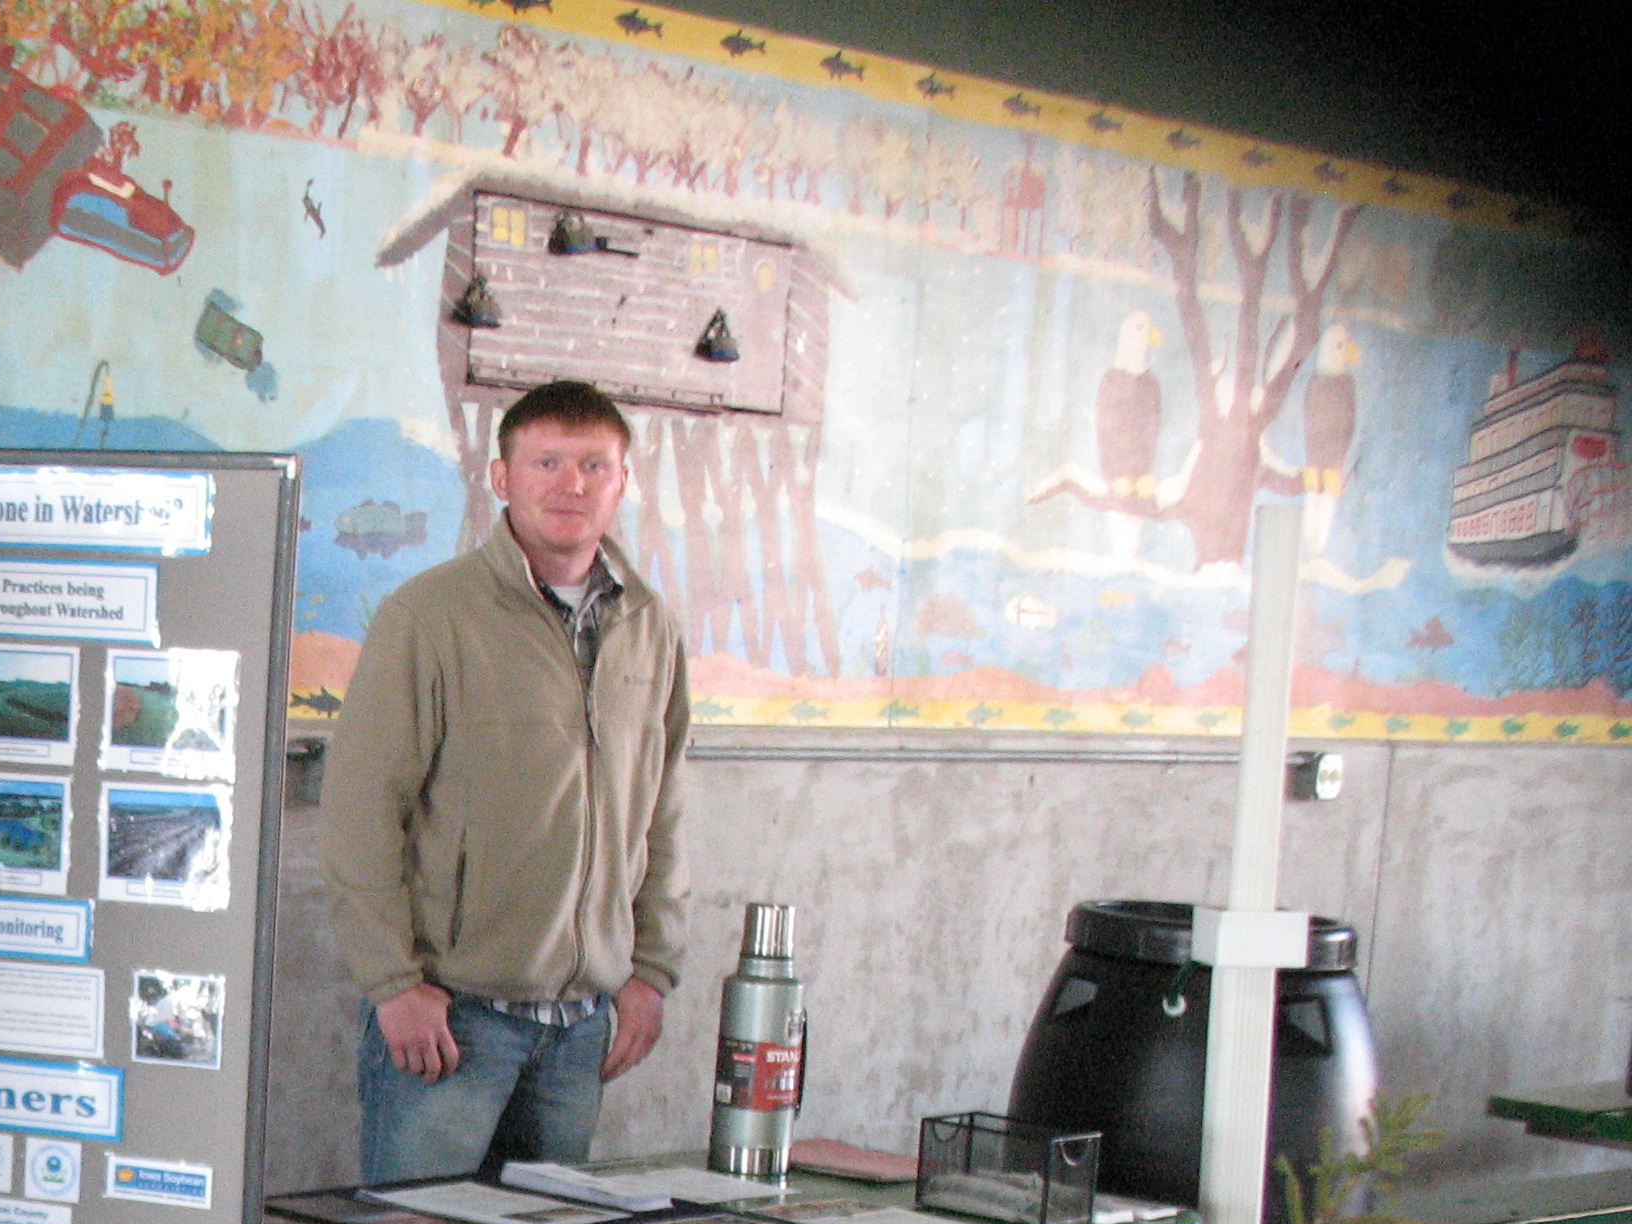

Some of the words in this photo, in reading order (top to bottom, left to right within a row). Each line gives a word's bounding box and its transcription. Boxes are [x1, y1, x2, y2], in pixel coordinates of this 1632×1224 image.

[34, 497, 54, 523] in
[3, 579, 63, 595] Practices
[67, 582, 105, 599] being
[56, 603, 124, 620] Watershed
